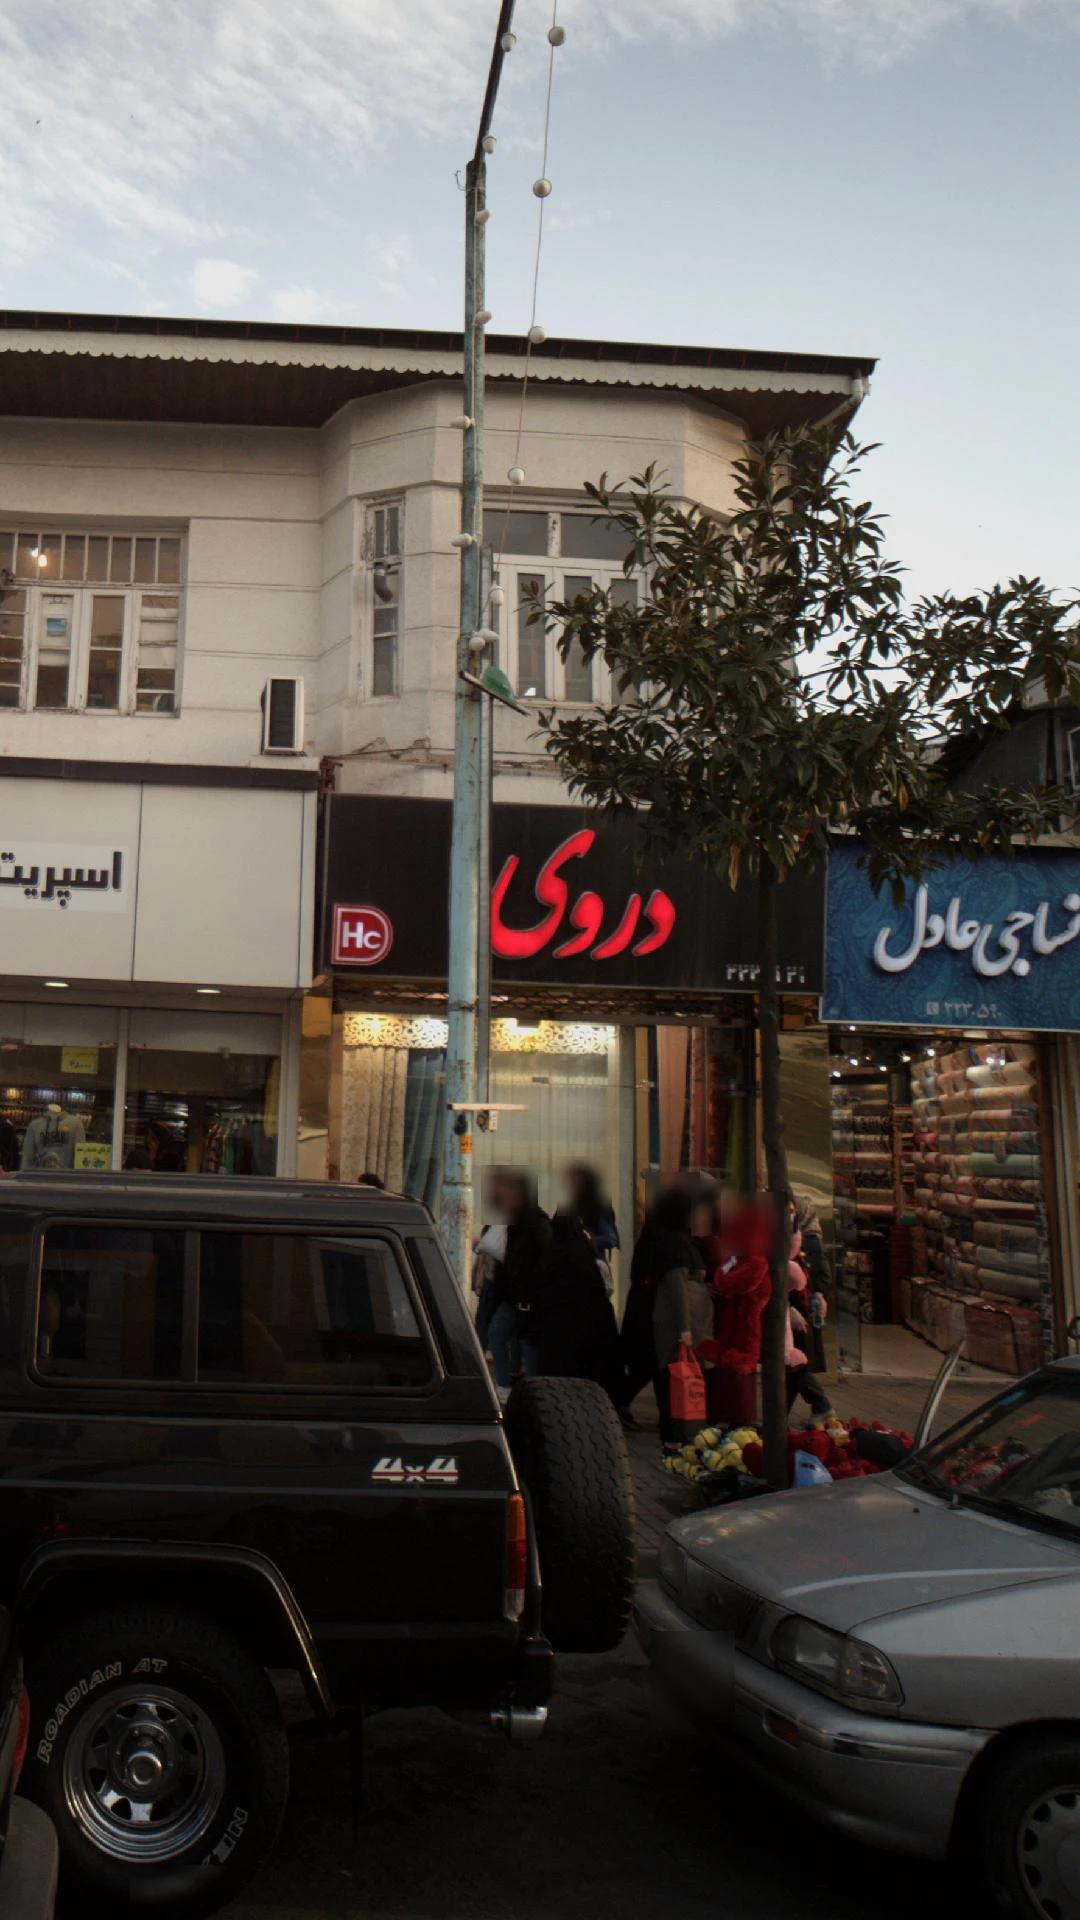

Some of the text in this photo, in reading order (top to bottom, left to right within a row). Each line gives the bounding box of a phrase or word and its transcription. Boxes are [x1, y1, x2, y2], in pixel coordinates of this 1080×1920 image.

[873, 882, 981, 973] عادل
[36, 1657, 169, 1764] ROADIAN AT
